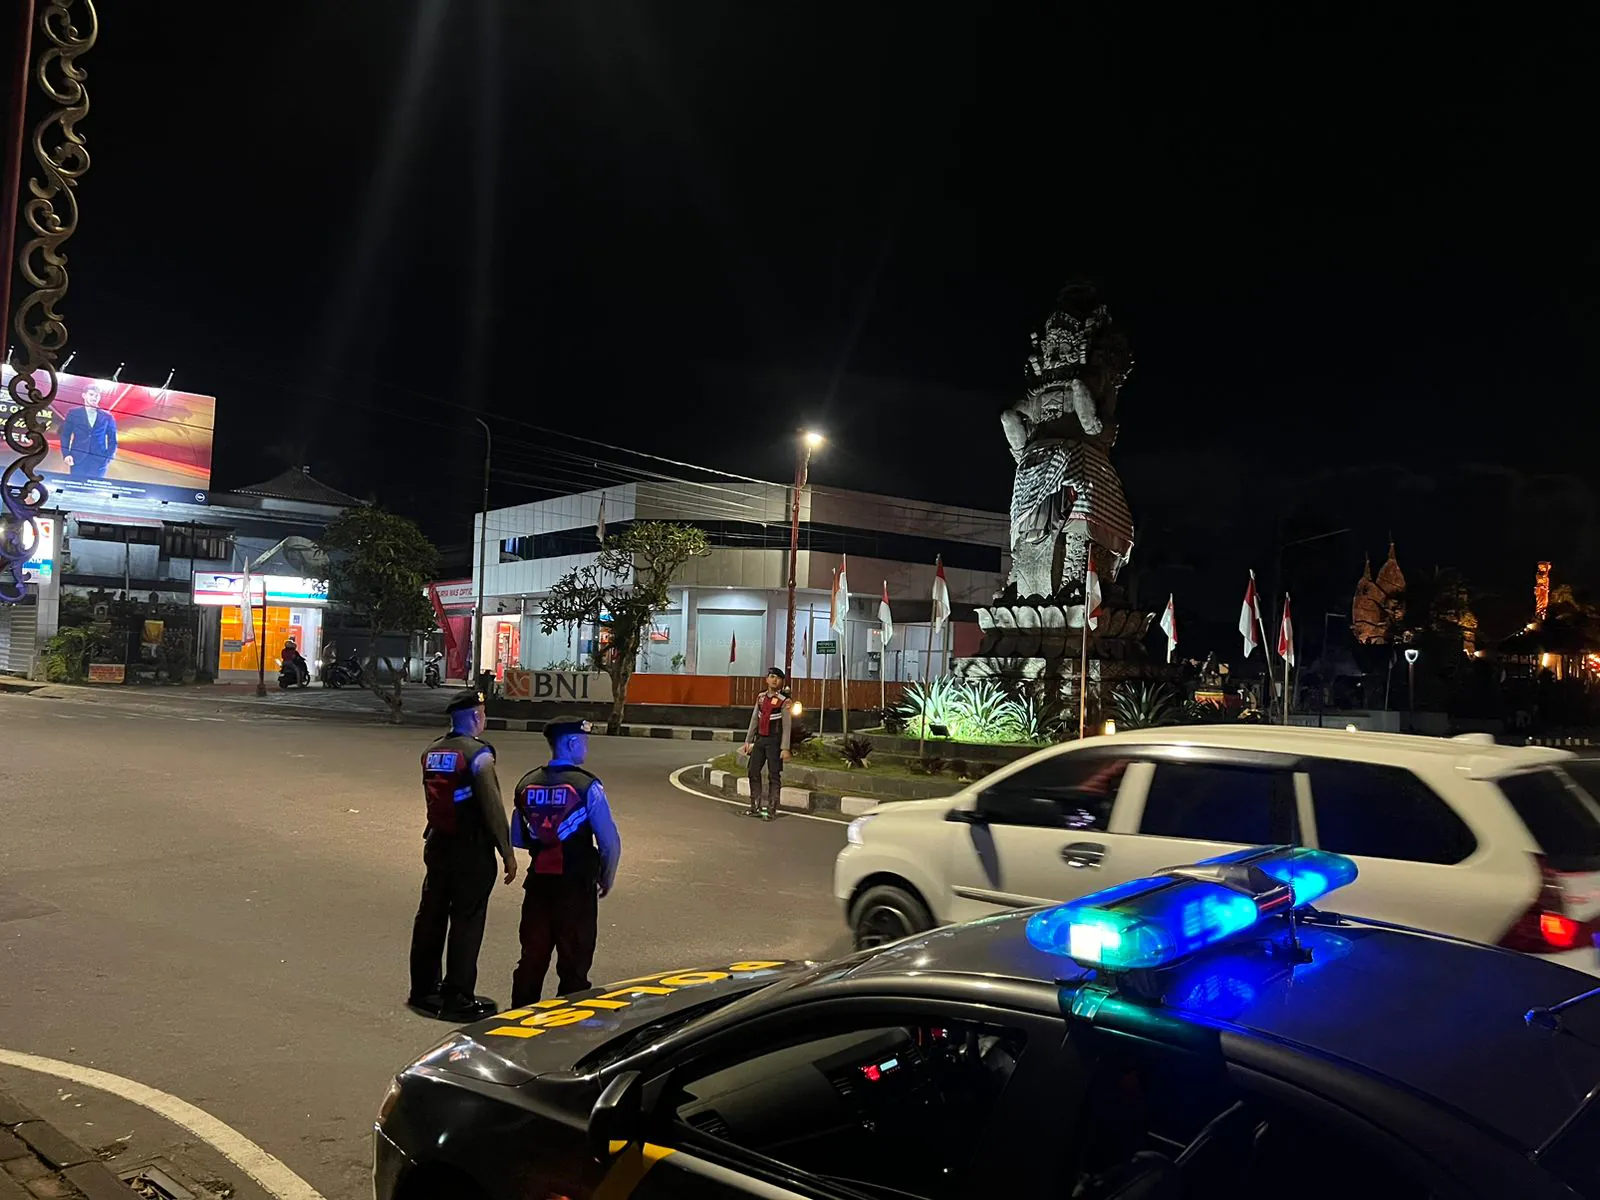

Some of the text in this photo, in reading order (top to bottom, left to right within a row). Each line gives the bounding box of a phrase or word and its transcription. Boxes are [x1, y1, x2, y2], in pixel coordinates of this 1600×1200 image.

[534, 673, 589, 699] BNI
[427, 753, 456, 770] POLISI
[527, 789, 566, 805] POLISI
[484, 961, 786, 1038] POLISI
